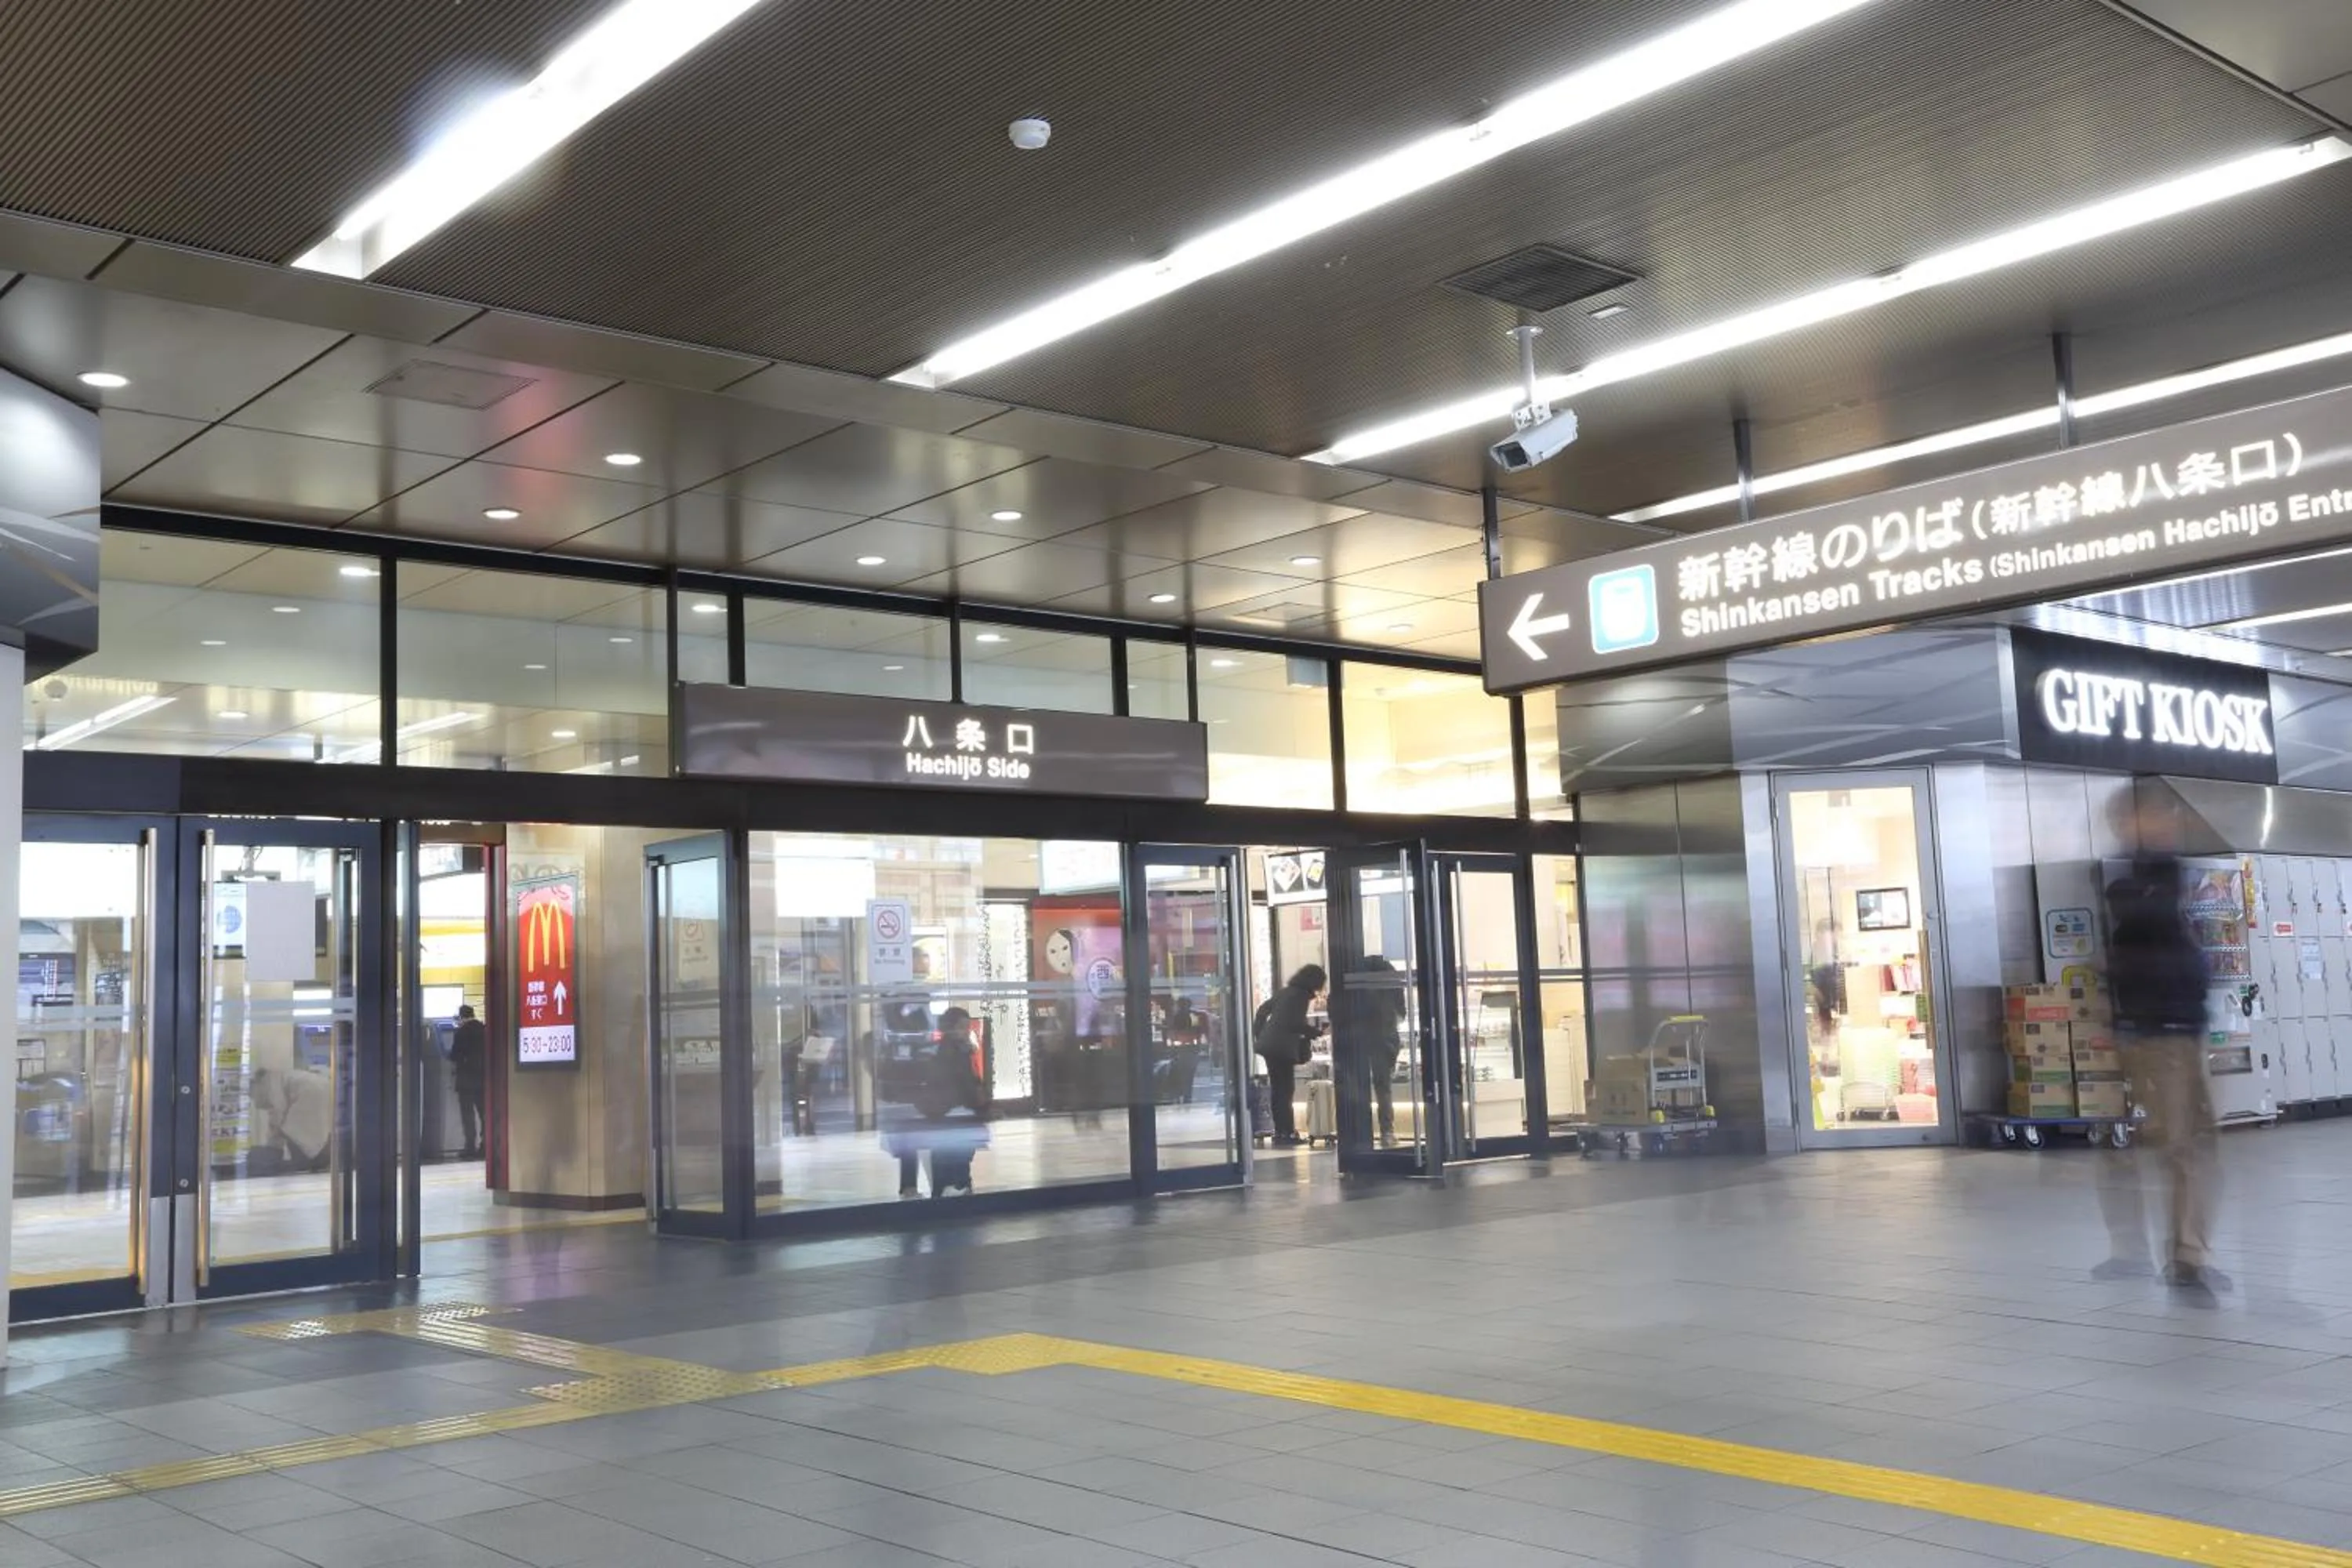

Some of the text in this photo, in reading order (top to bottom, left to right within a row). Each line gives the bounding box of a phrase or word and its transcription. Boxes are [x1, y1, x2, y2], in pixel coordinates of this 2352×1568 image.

[1680, 583, 1861, 637] Shinkansen
[1868, 551, 1983, 601] Tracks
[1990, 528, 2156, 578] (Shinkansen
[2164, 501, 2279, 546] Hachijō
[902, 714, 1034, 755] 八条口
[2041, 668, 2273, 755] GIFT KIOSK
[906, 752, 1030, 781] Hachijō Side
